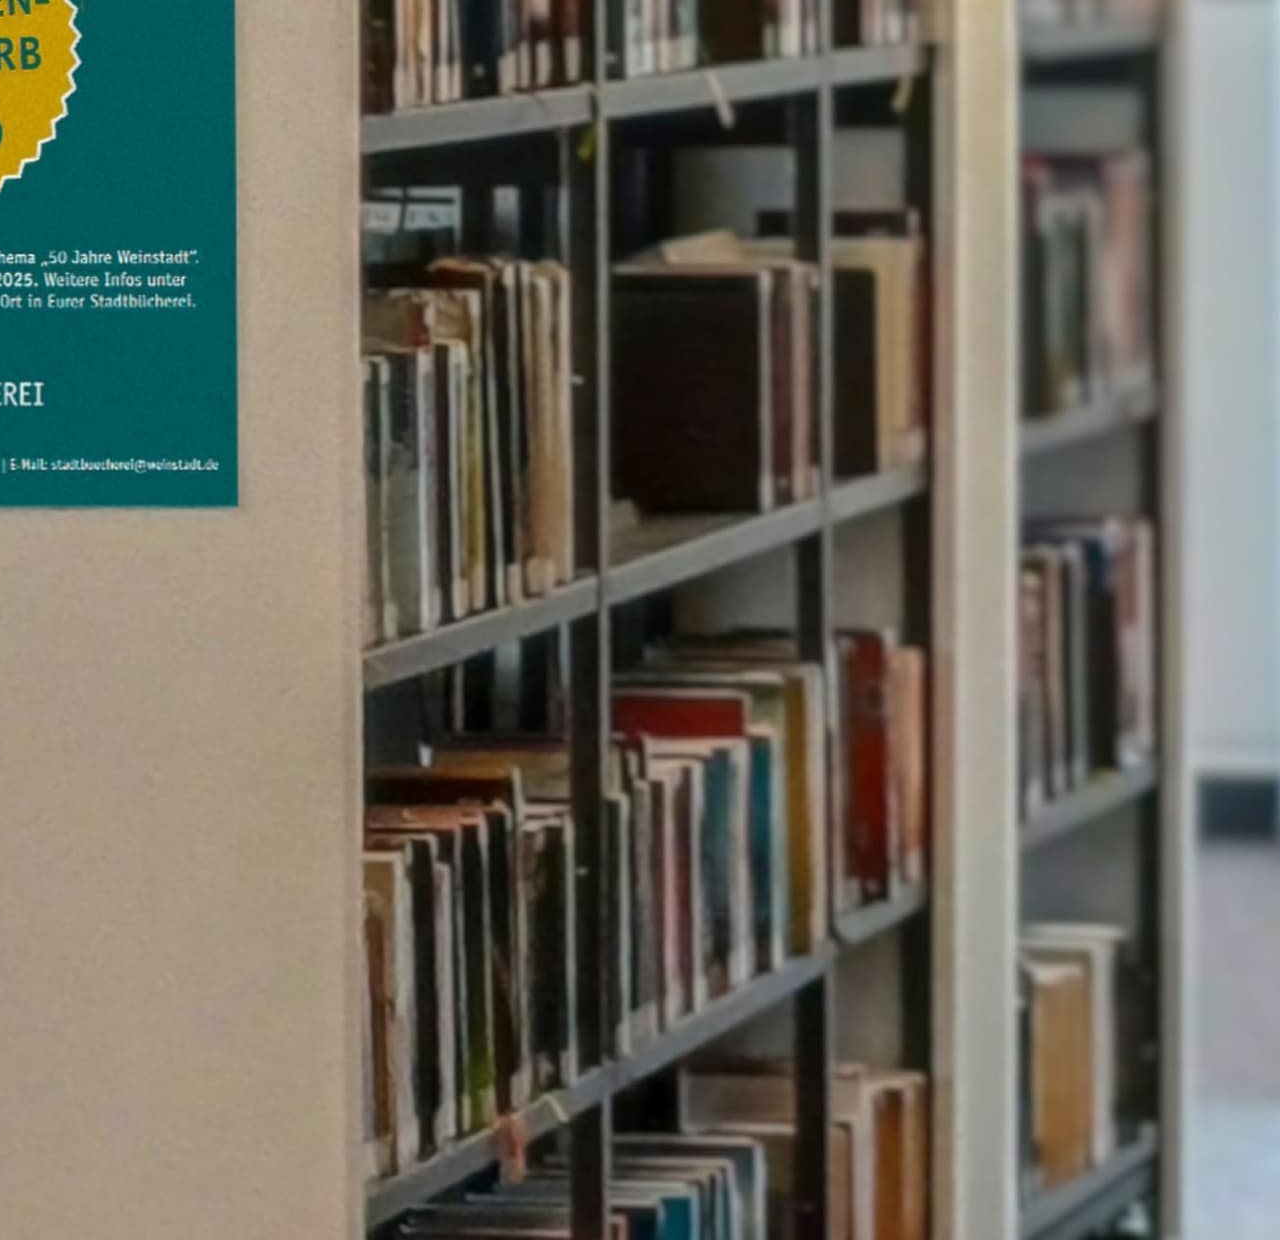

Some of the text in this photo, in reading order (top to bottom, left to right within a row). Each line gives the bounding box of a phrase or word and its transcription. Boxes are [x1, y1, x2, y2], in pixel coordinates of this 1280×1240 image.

[71, 249, 113, 265] Jahre
[43, 271, 100, 287] Weitere
[104, 271, 143, 287] Infos
[147, 273, 187, 287] unter
[0, 293, 23, 308] Ort
[27, 293, 43, 307] in
[47, 293, 85, 308] Eurer
[90, 293, 197, 308] Stadtbücherei.
